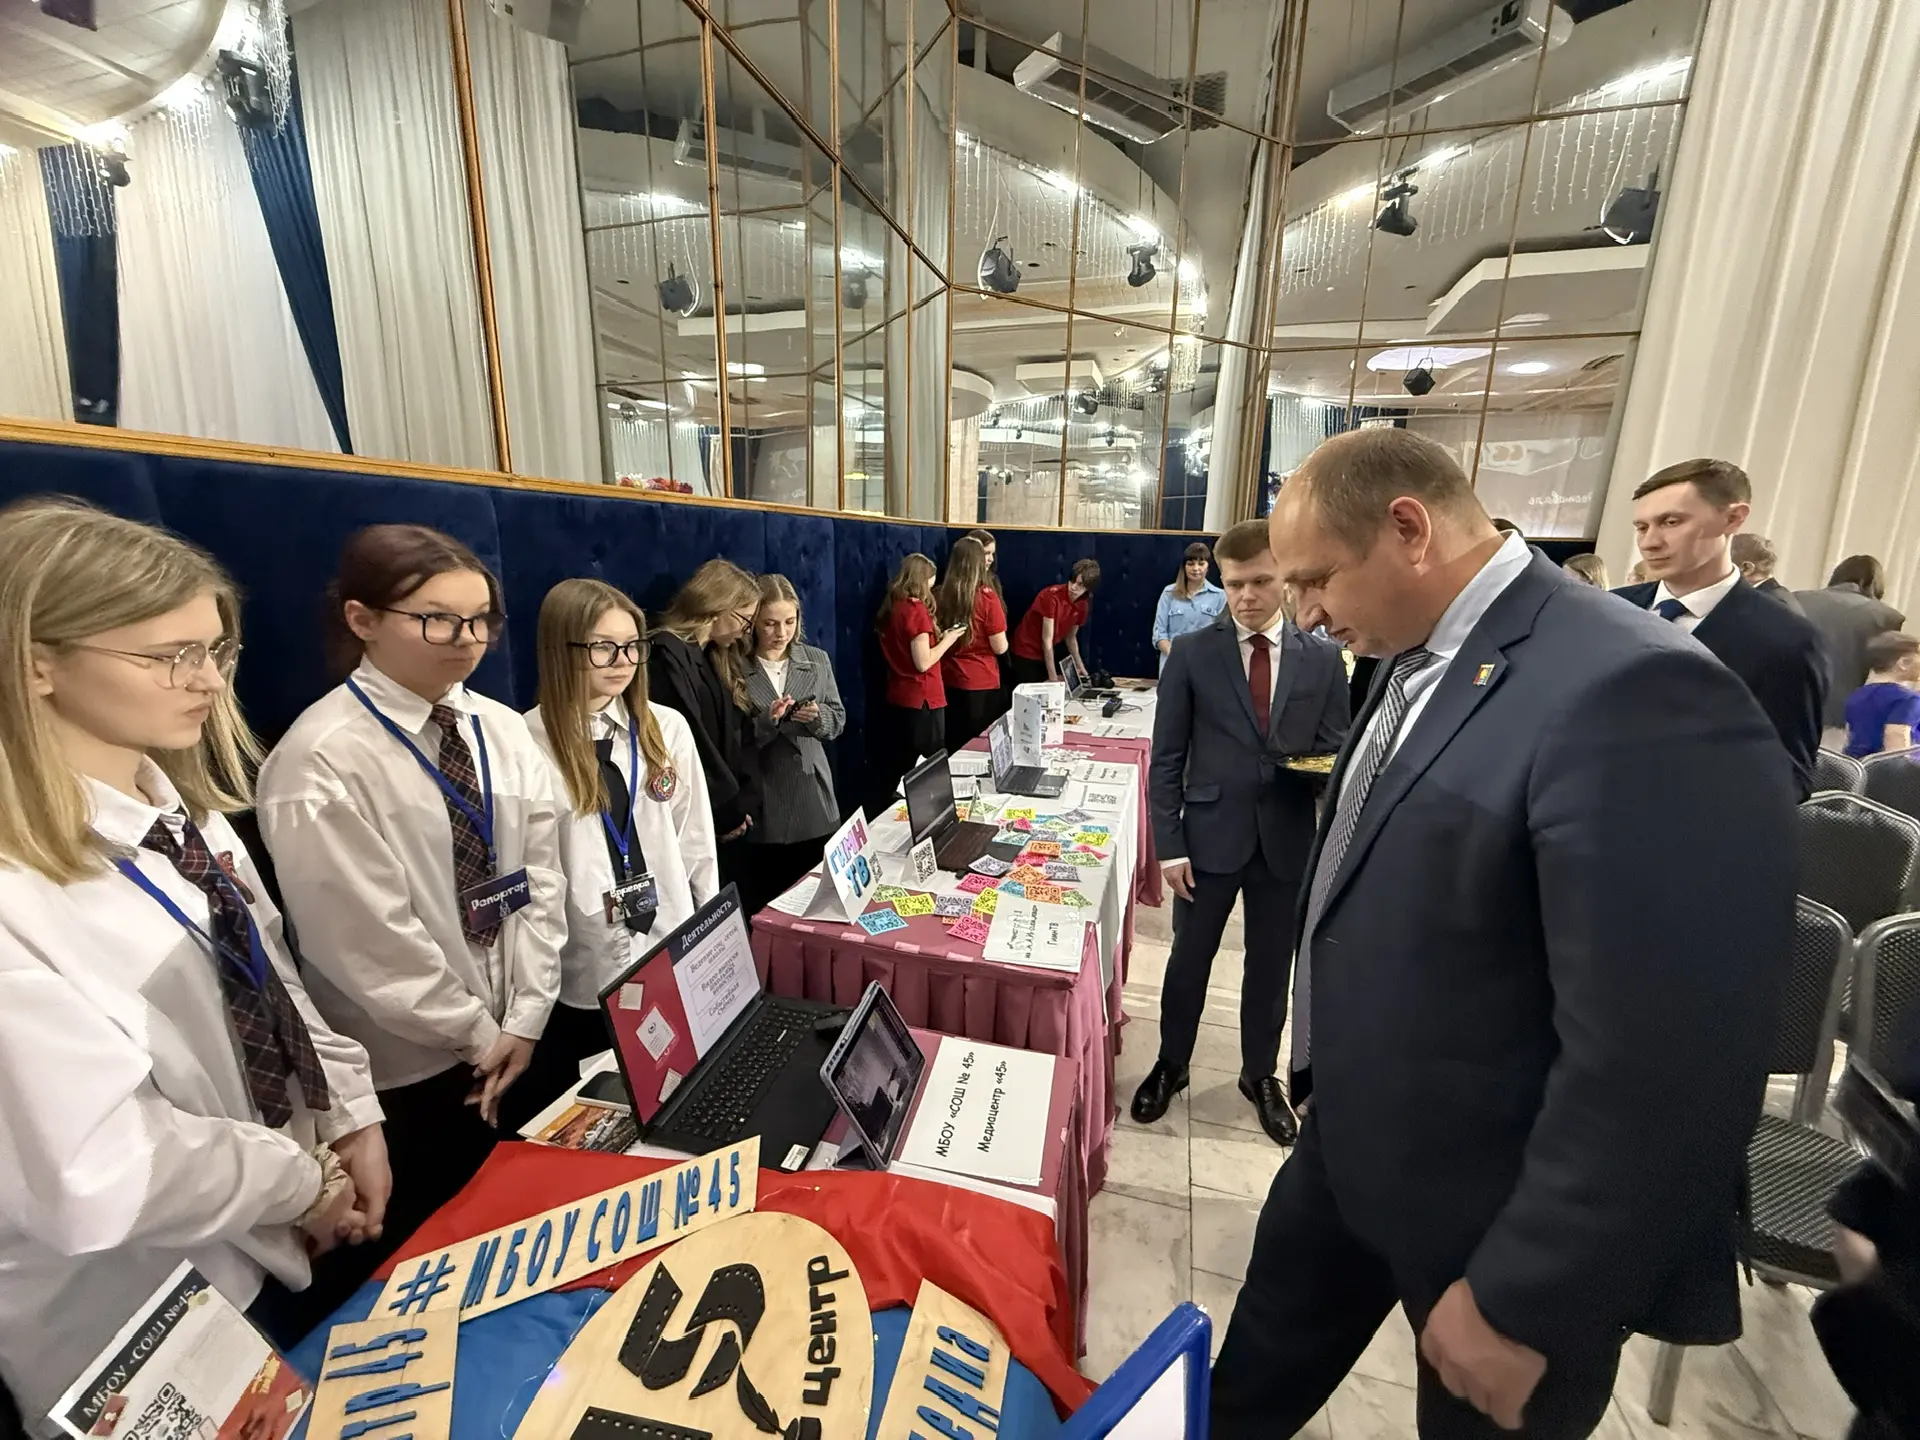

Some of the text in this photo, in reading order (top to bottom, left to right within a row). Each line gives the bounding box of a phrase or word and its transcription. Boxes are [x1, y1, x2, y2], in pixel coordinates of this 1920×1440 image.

[829, 818, 868, 874] ГИМН
[845, 854, 871, 898] ТВ
[681, 900, 733, 951] Деятельность
[935, 1121, 955, 1157] МБОУ
[949, 1088, 966, 1119] «СОШ
[977, 1060, 1008, 1153] Медиацентр «45»
[587, 1178, 662, 1263] СОШ
[802, 1255, 849, 1406] центр
[908, 1325, 1000, 1440] едиа
